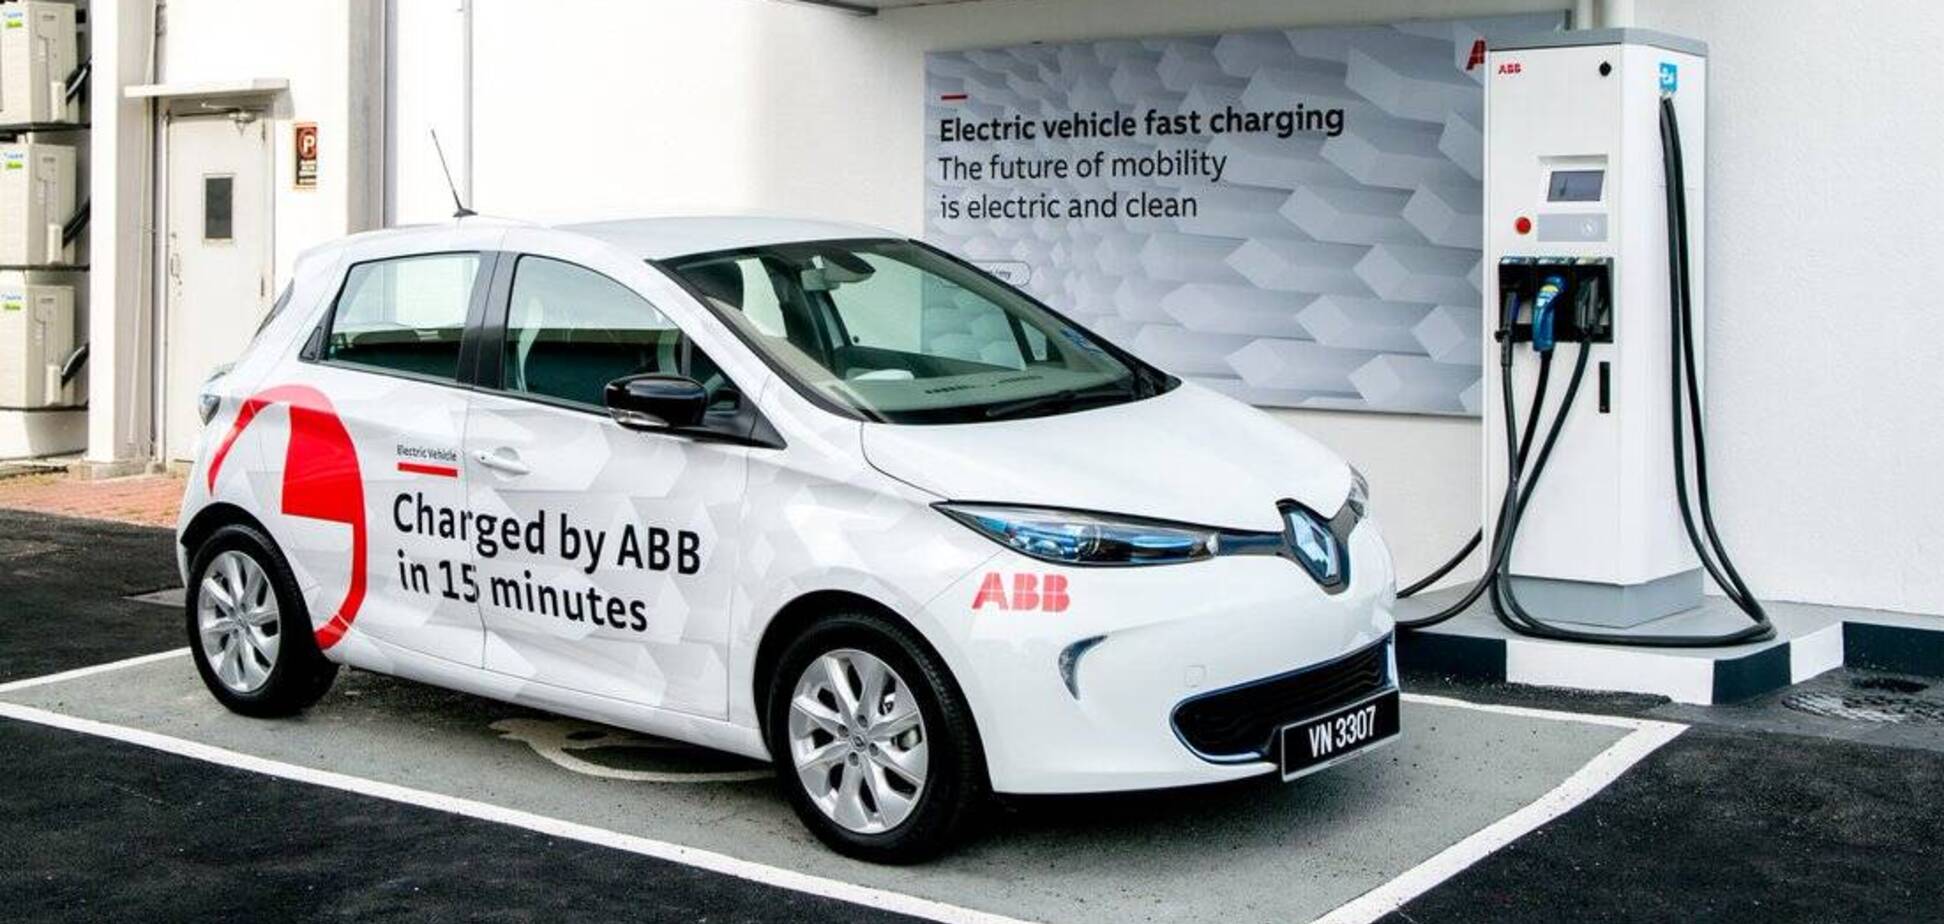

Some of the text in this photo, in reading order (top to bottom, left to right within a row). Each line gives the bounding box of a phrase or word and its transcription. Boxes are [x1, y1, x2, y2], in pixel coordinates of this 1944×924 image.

[1498, 63, 1522, 75] ABB
[940, 103, 1345, 142] Electric vehicle fast charging
[938, 149, 1228, 183] The future of mobility
[941, 191, 1198, 219] is electric and clean
[397, 444, 457, 462] Electric Vehicle
[393, 491, 702, 576] Charged by ABB
[397, 547, 648, 633] in 15 minutes
[971, 571, 1071, 613] ABB
[1308, 704, 1377, 759] VN 3307
